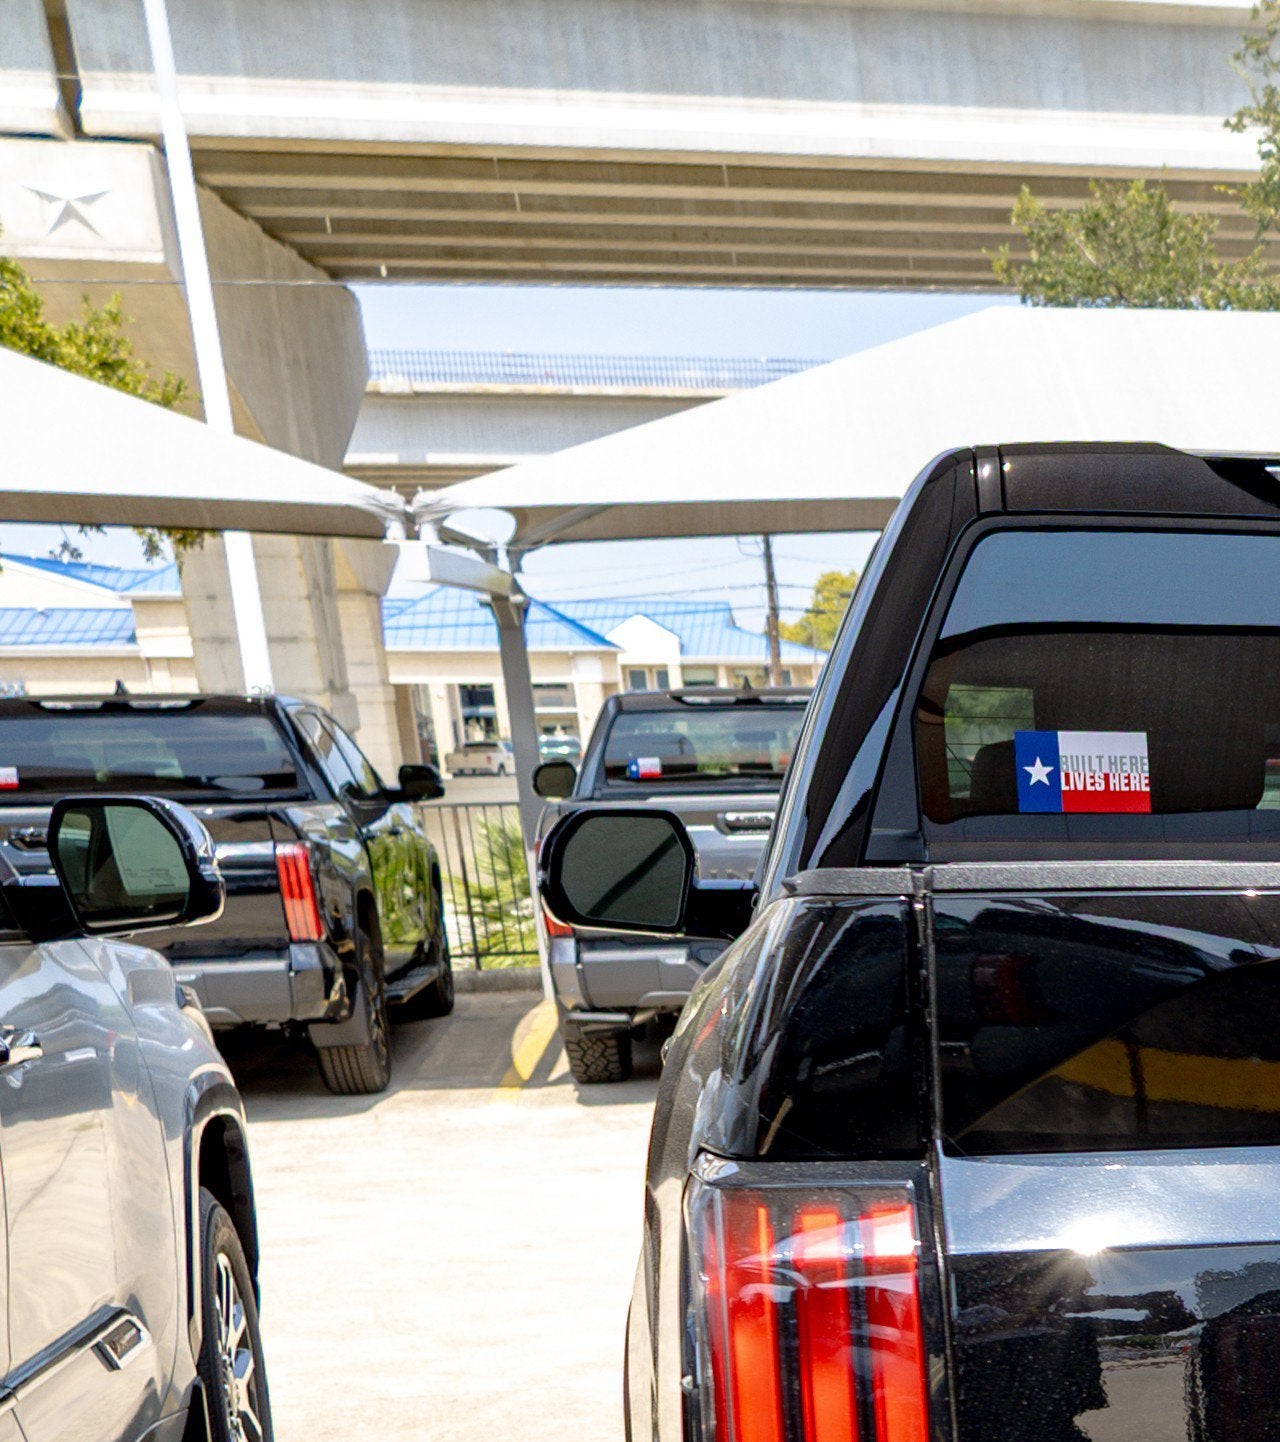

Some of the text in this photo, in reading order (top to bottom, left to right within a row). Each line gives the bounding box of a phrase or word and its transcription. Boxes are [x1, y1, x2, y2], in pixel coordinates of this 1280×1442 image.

[1060, 755, 1148, 773] BUILT HERE
[1061, 772, 1150, 792] LIVES HERE
